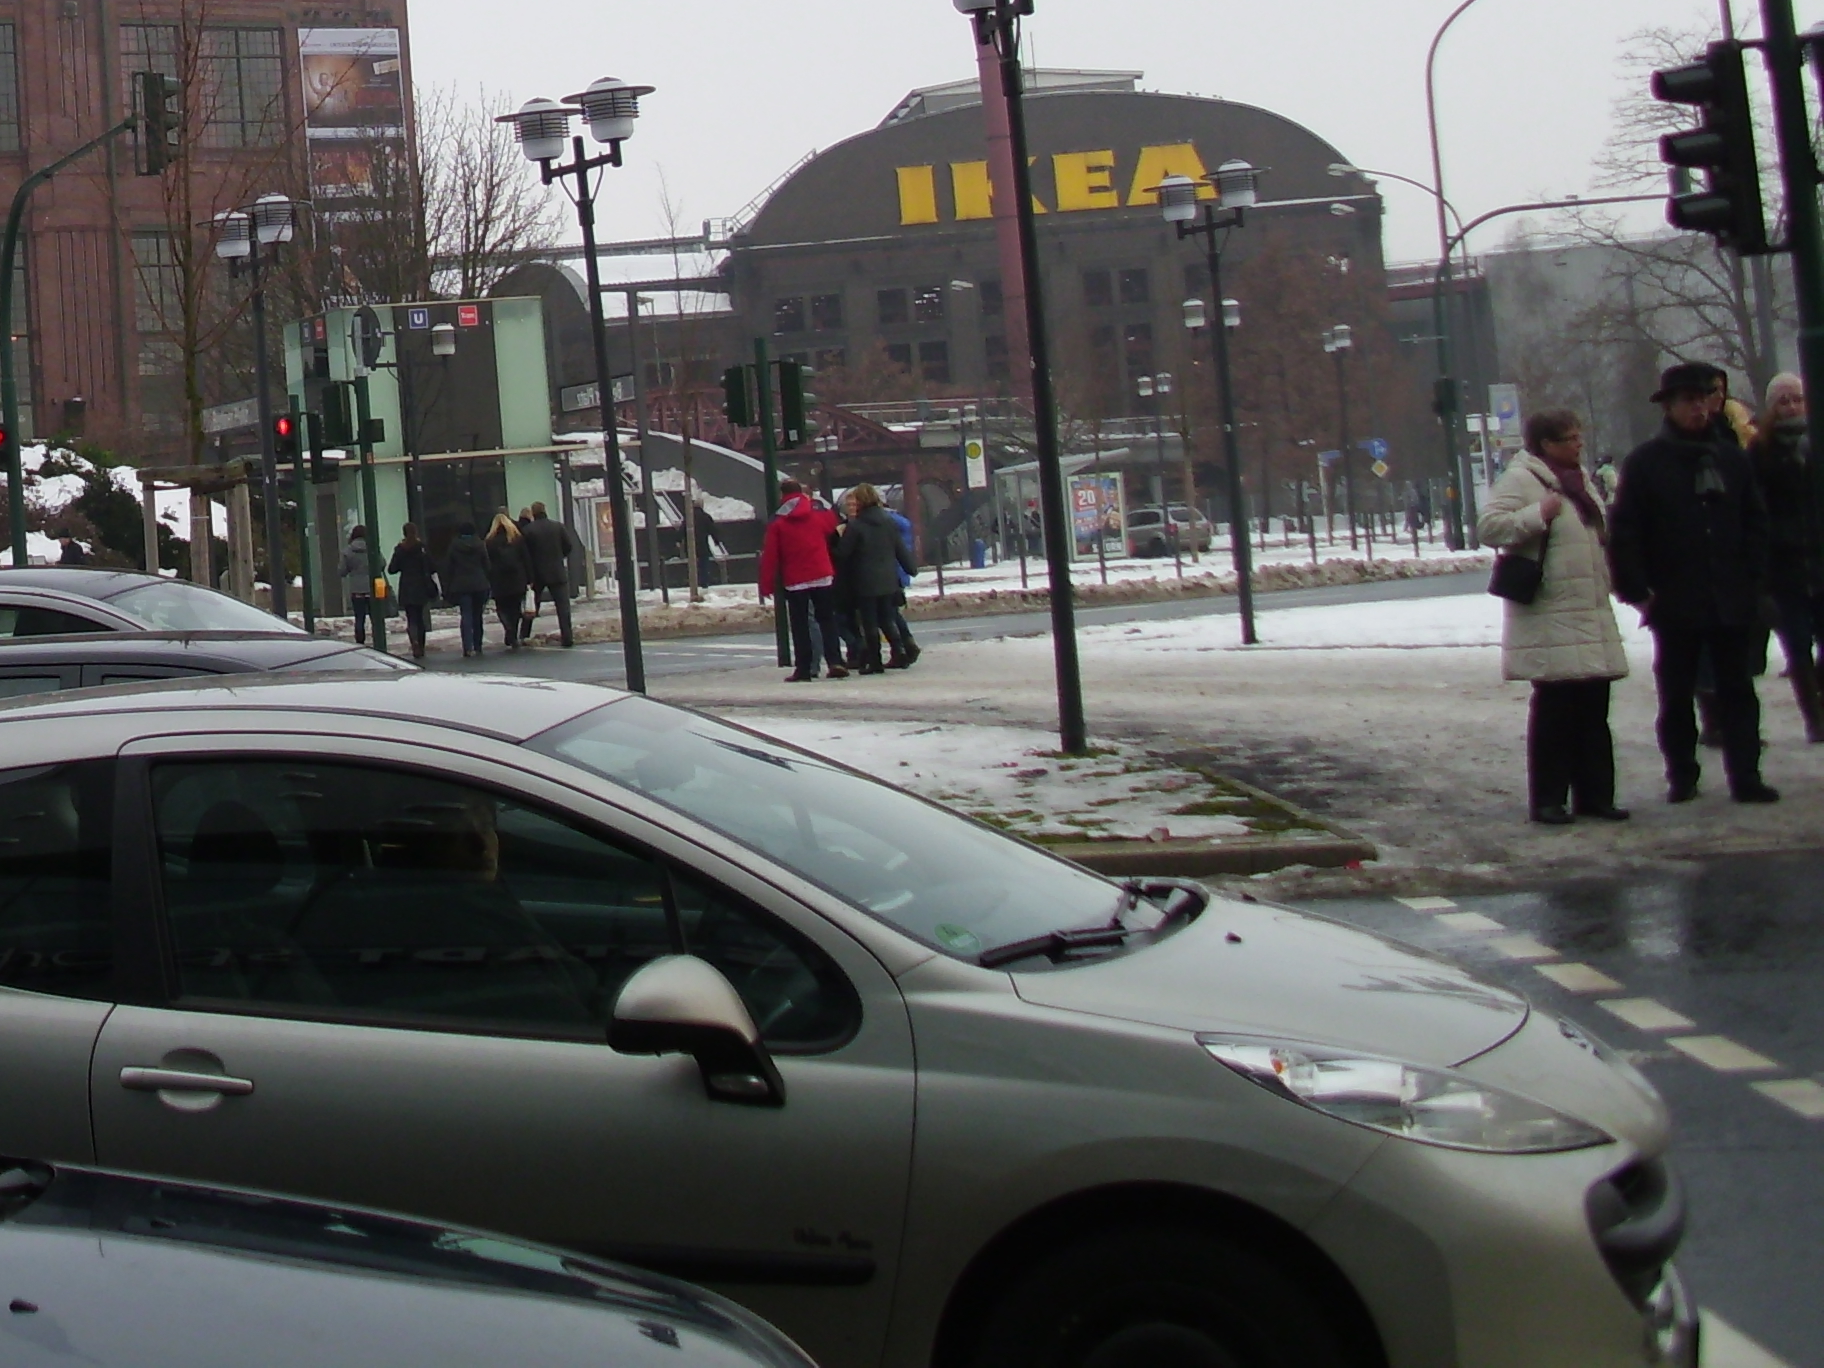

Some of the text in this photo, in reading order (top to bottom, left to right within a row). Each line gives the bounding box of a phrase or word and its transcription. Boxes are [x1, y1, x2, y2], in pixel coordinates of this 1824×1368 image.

[896, 142, 1218, 225] IKEA
[414, 313, 423, 324] U
[1078, 490, 1096, 506] 20
